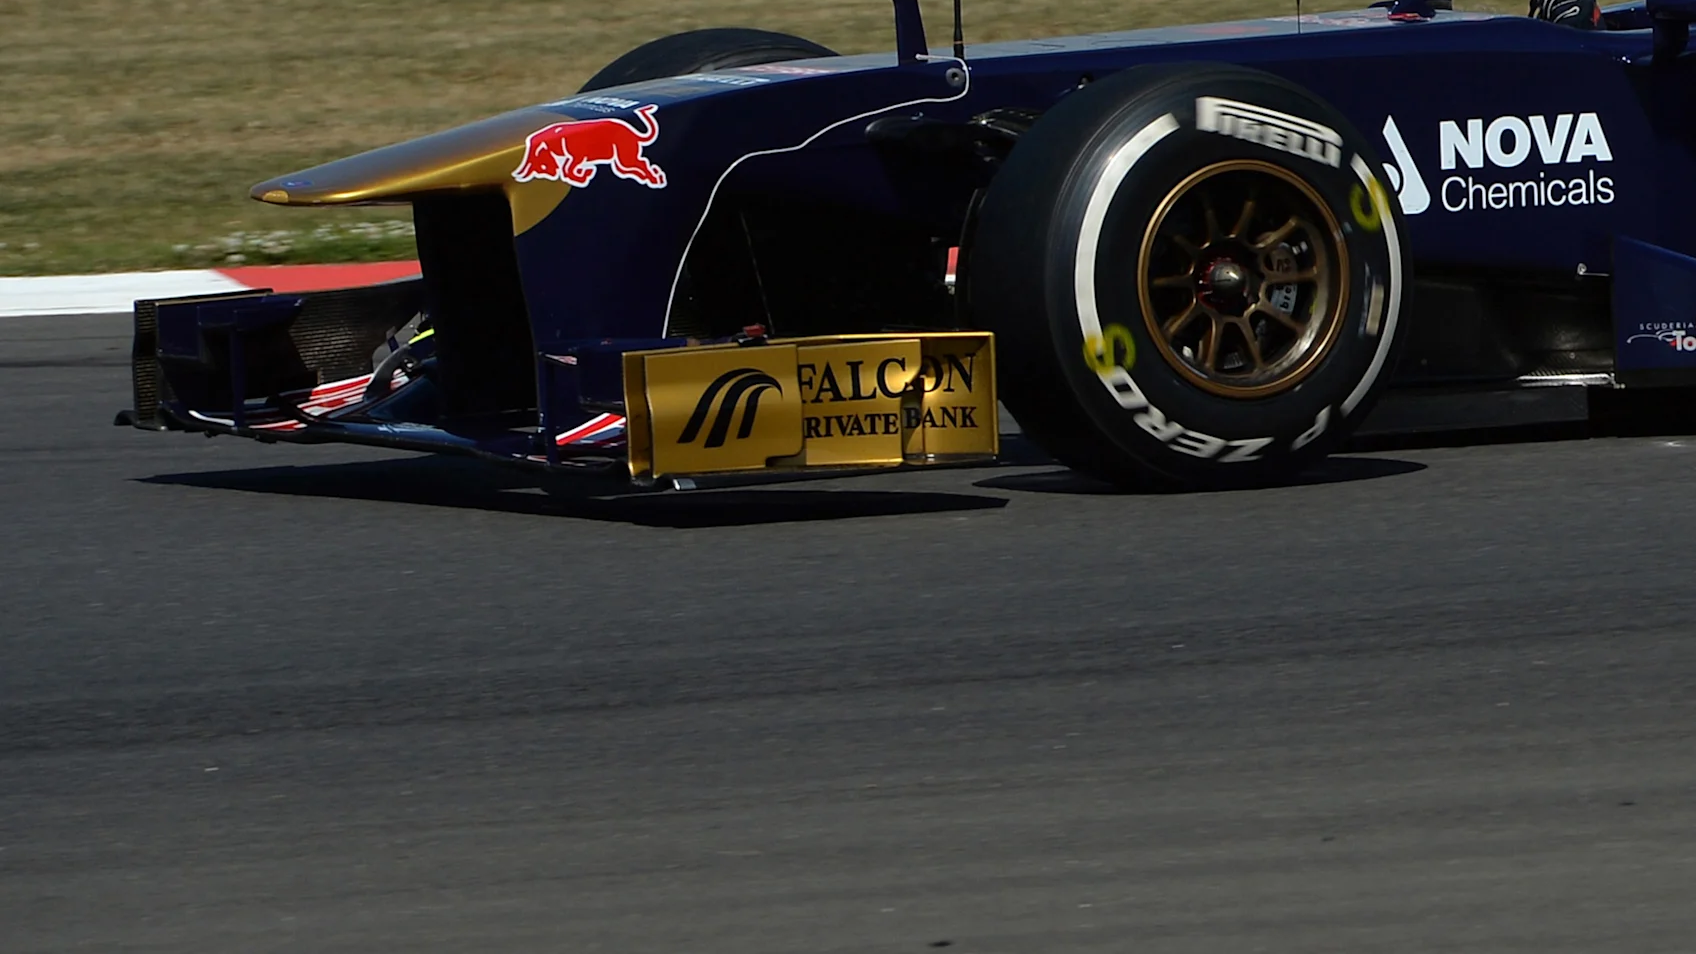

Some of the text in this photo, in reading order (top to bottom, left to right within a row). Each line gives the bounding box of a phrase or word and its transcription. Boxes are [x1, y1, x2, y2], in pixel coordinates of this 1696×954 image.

[1196, 96, 1343, 168] PIRELLI
[1439, 112, 1613, 170] NOVA
[1441, 169, 1615, 212] Chemicals
[1640, 322, 1694, 331] SCUDERIA
[797, 353, 976, 404] FALCON
[805, 406, 978, 438] RIVATE BANK
[1100, 367, 1274, 463] ZERO
